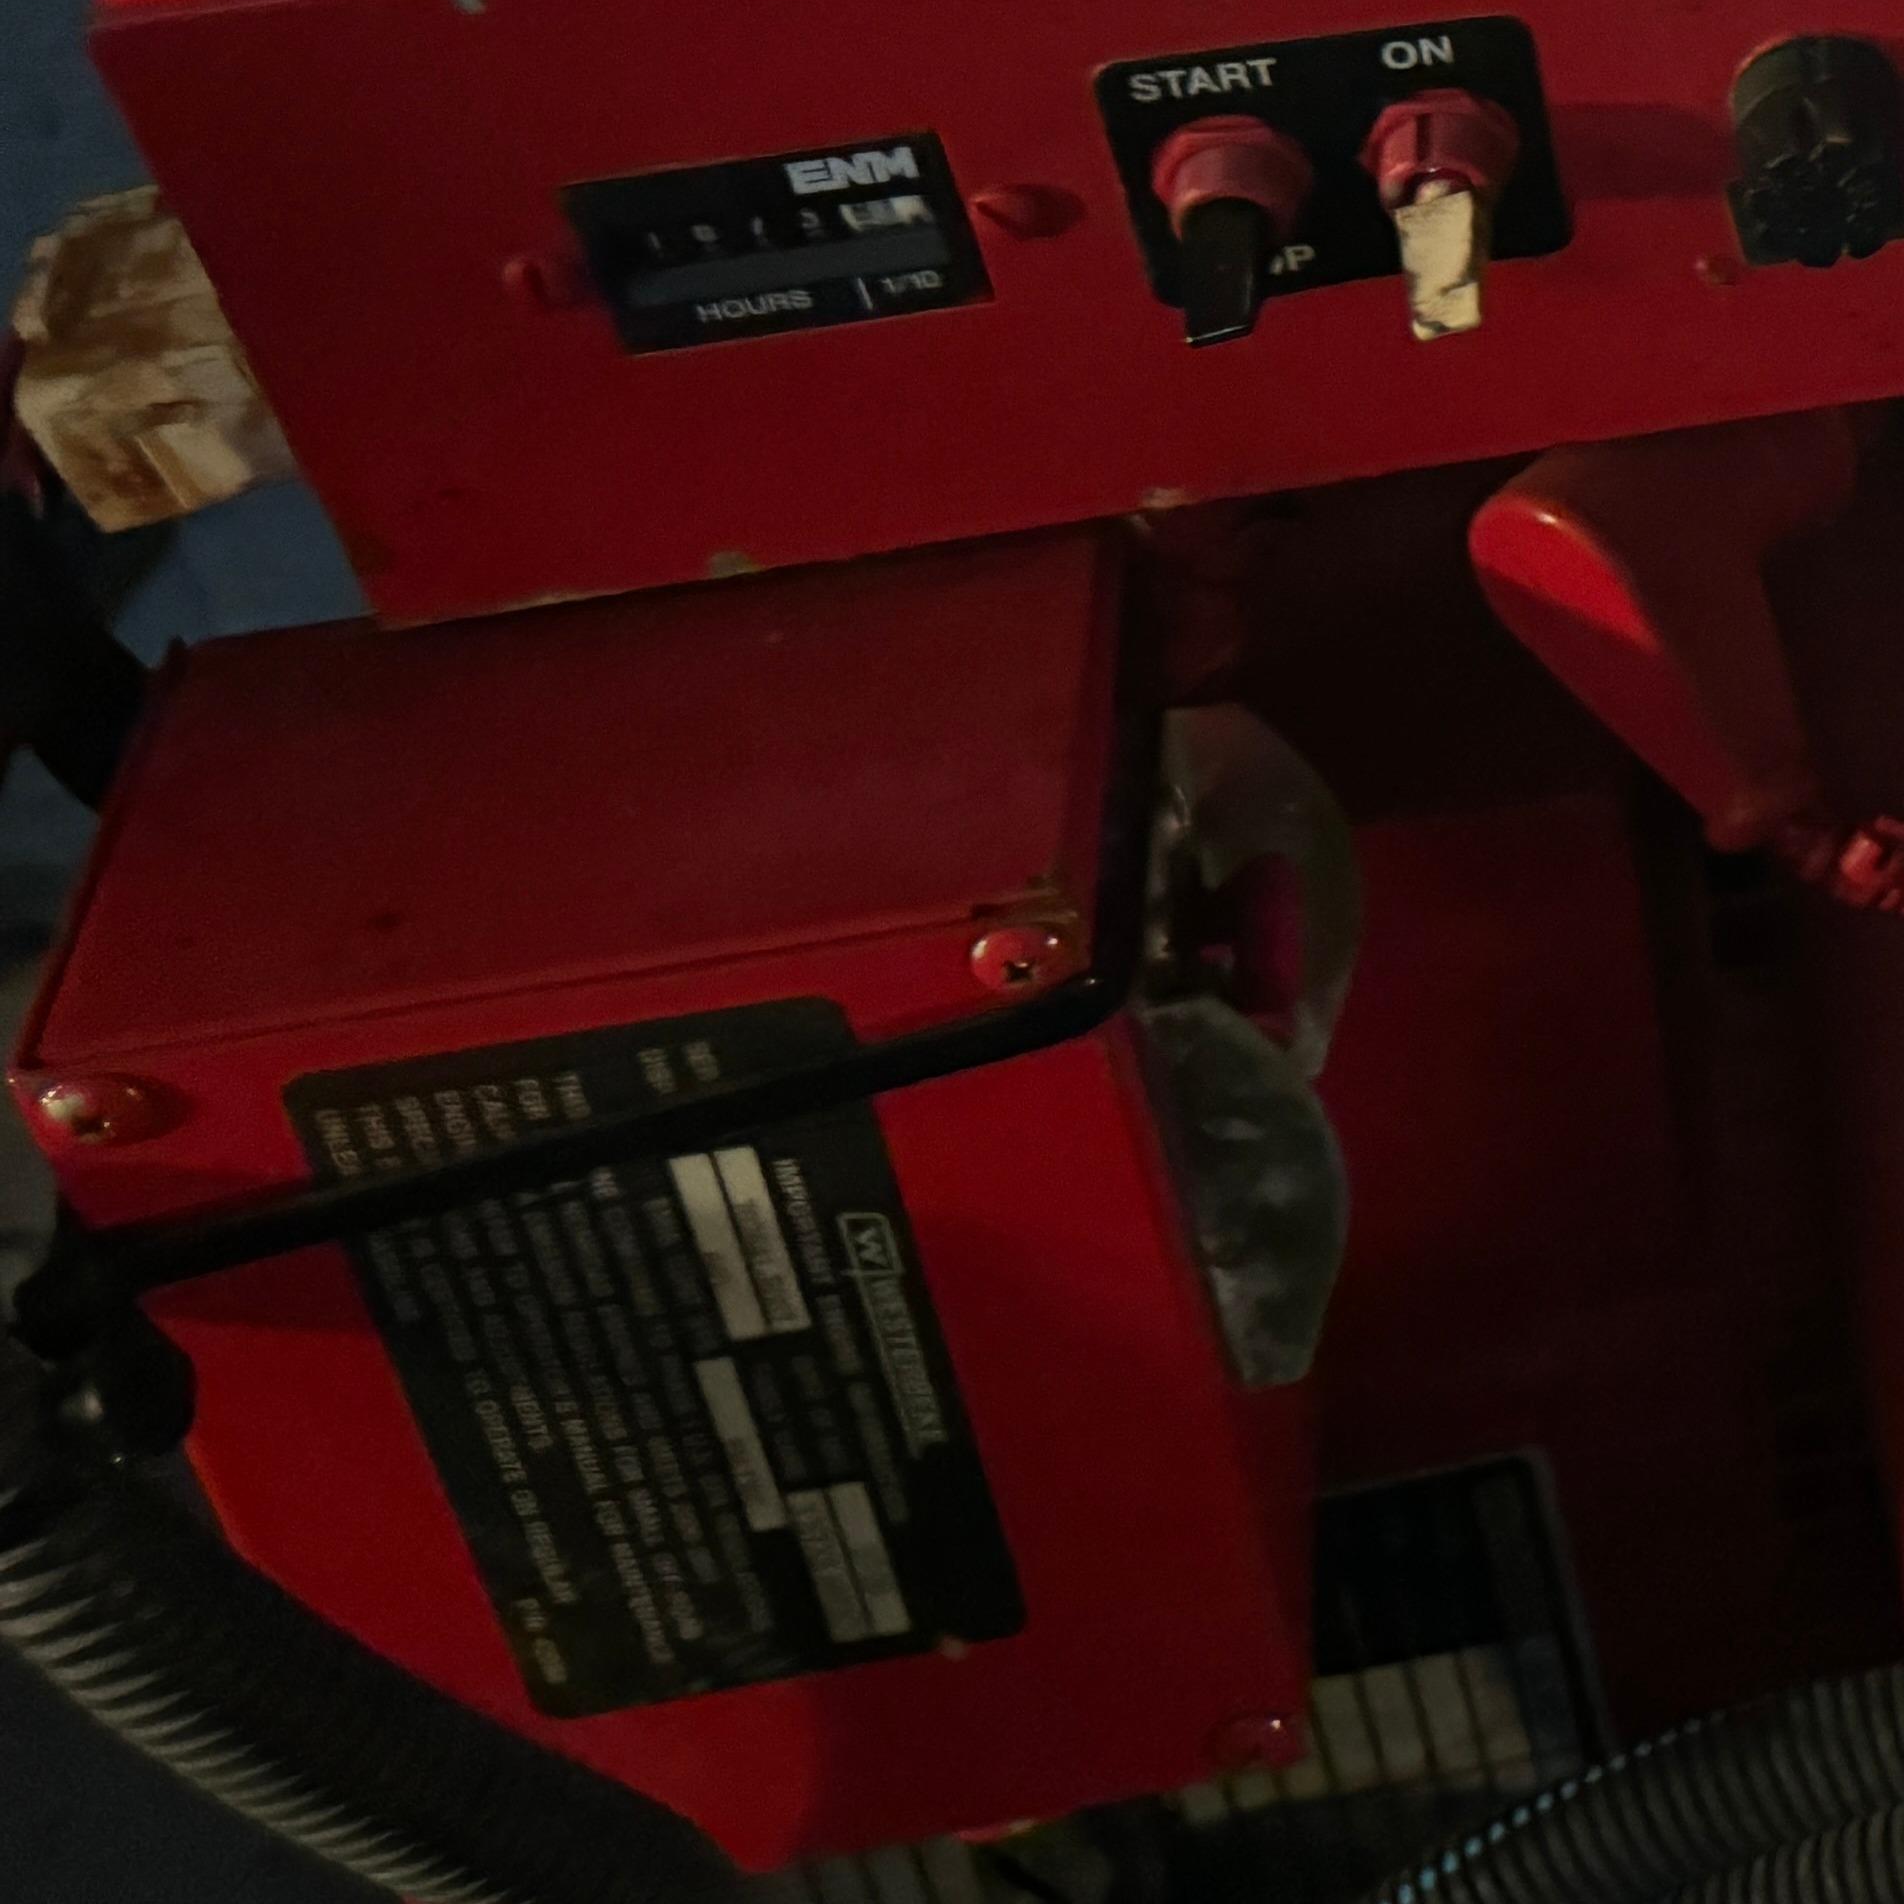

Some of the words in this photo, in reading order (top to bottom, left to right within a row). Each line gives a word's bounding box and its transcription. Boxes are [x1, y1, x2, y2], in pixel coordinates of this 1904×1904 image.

[1380, 34, 1455, 70] ON
[1128, 57, 1277, 104] START
[783, 145, 921, 195] ENM
[696, 288, 815, 324] HOURS
